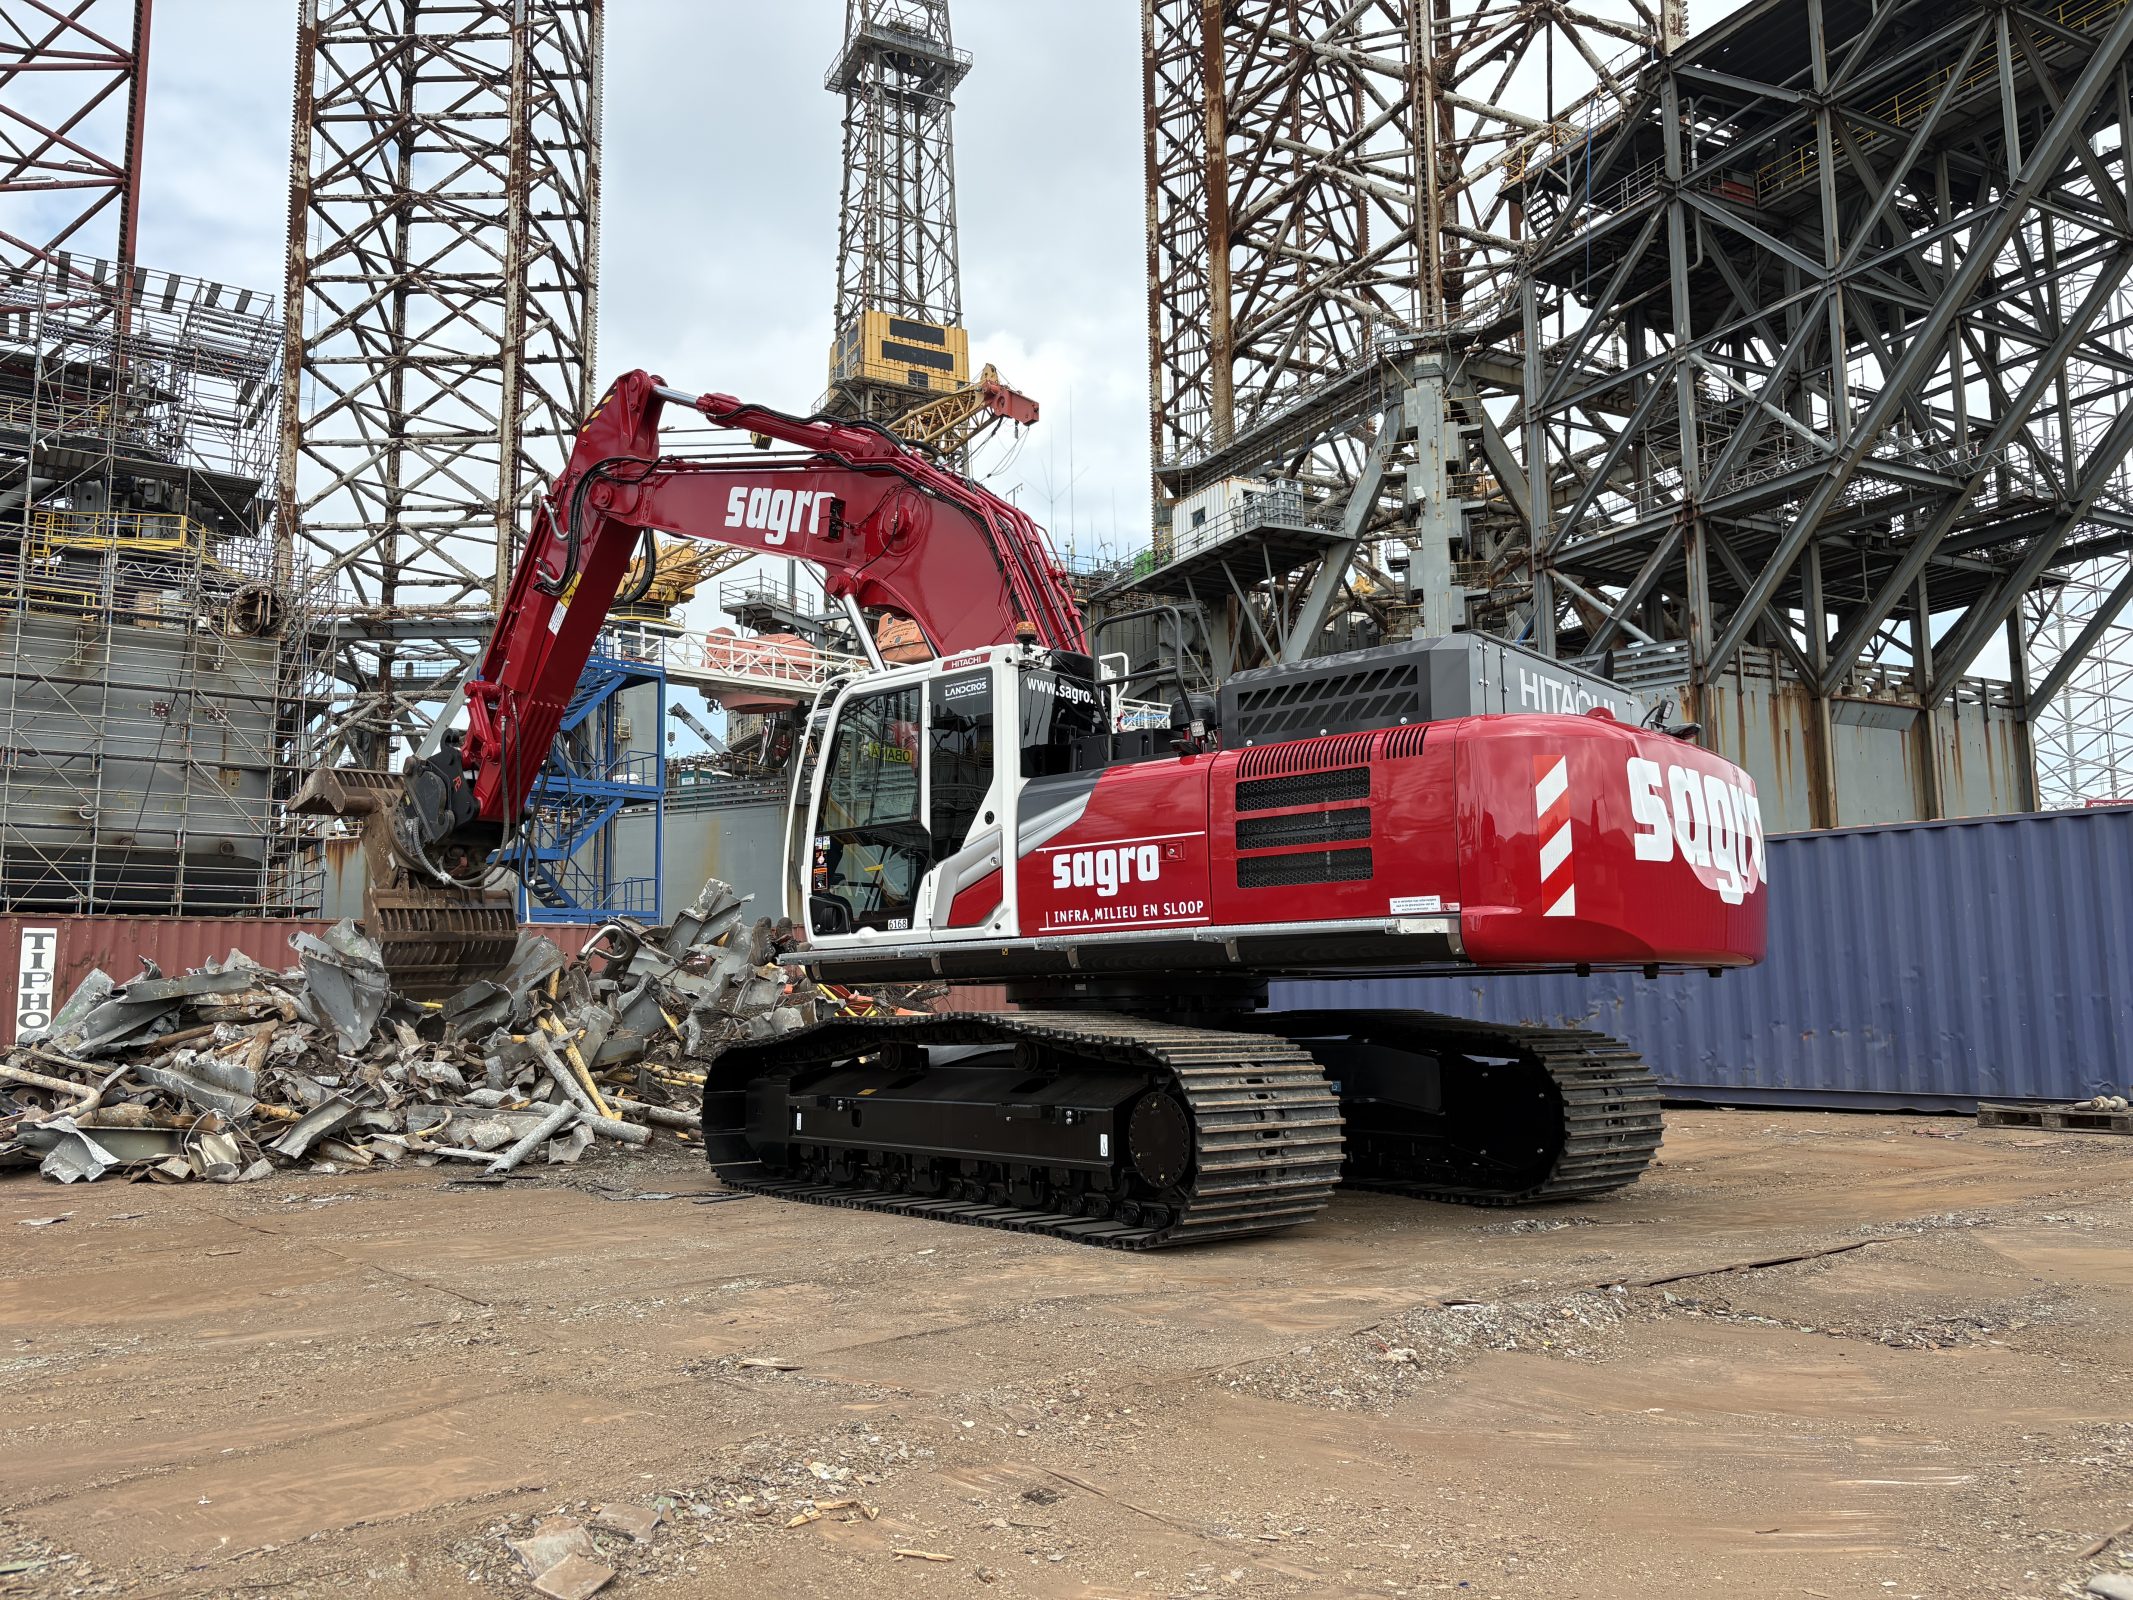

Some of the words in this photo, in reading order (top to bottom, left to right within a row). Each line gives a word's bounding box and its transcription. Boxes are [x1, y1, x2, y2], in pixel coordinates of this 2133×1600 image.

[951, 656, 982, 669] HITACHI
[945, 681, 987, 697] LANDCROS
[1026, 676, 1106, 708] www.sagro.l
[1626, 756, 1768, 906] sagro
[1052, 844, 1161, 897] sagro
[1143, 903, 1159, 917] EN
[1163, 900, 1205, 916] SLOOP
[888, 919, 908, 930] 6168
[17, 932, 56, 1029] TIPHO
